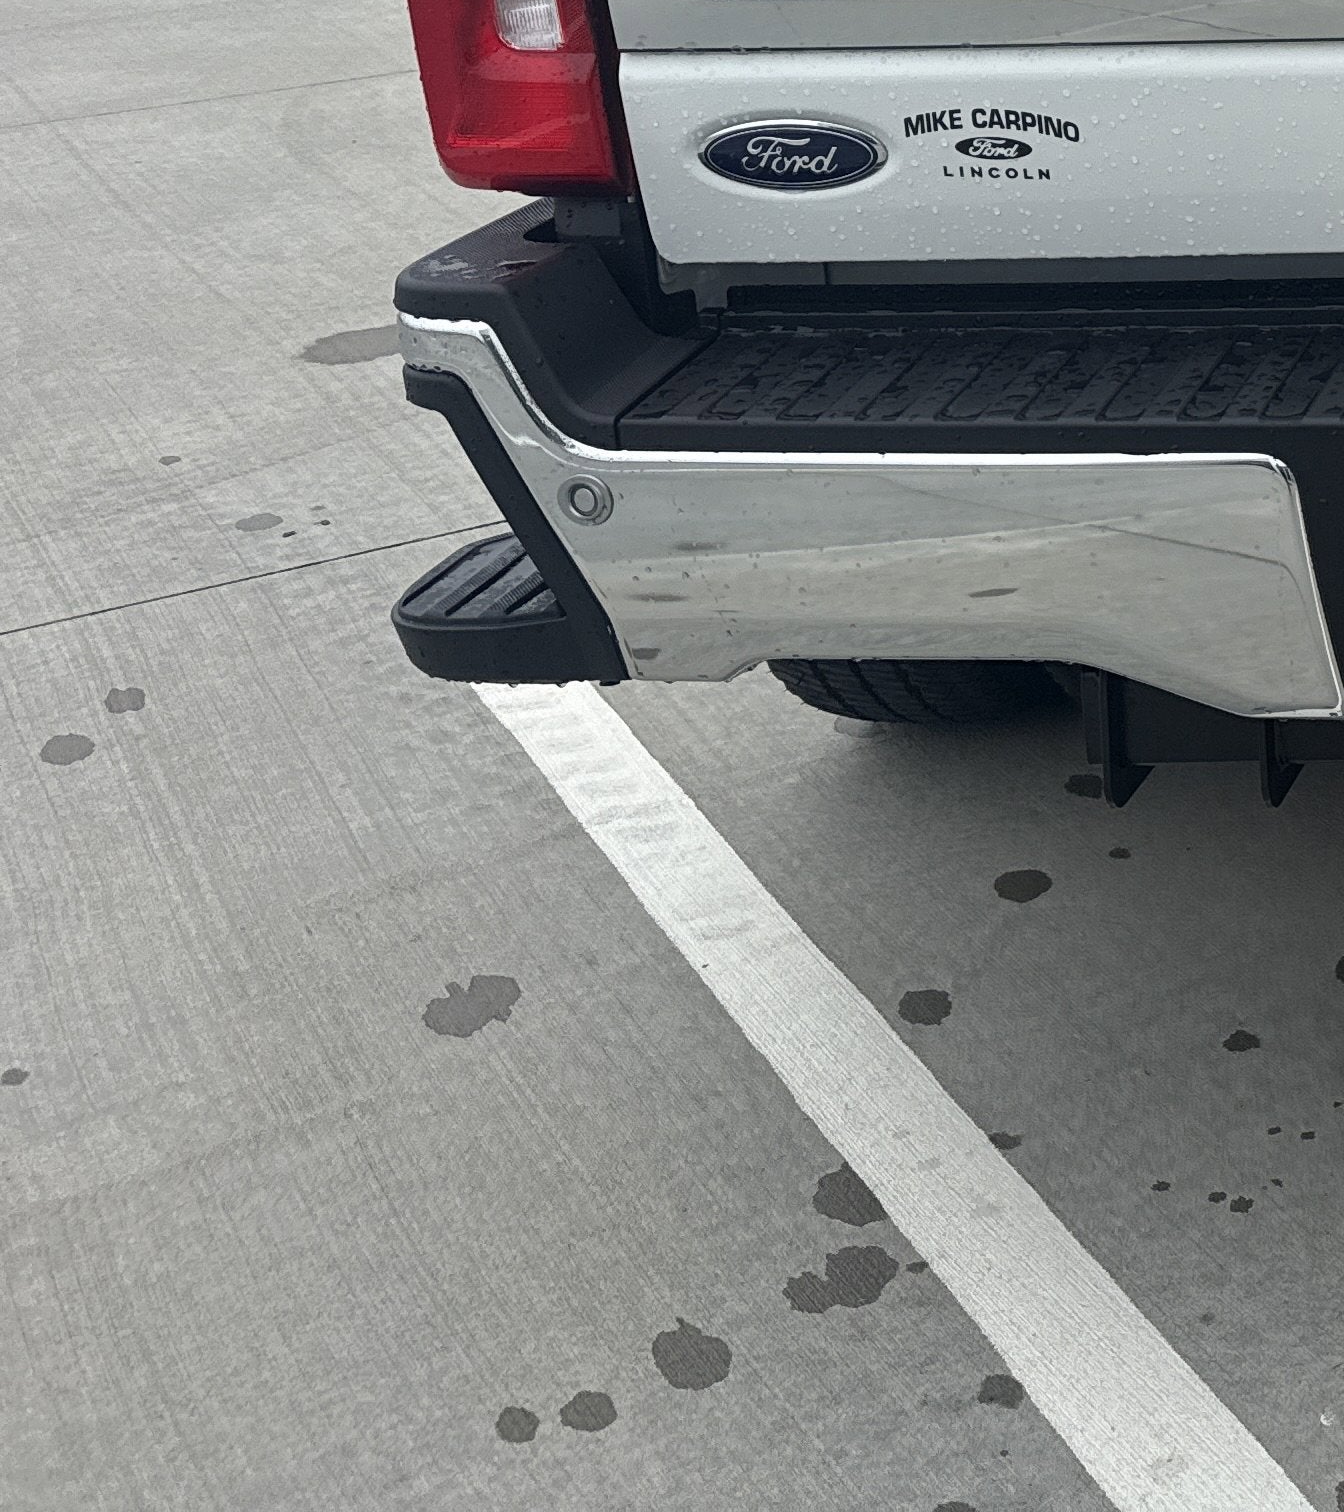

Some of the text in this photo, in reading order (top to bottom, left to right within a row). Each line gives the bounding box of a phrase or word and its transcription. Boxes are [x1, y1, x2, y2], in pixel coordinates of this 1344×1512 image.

[903, 107, 1081, 143] MIKE CARPINO
[741, 135, 839, 176] Ford
[968, 137, 1021, 159] Ford
[942, 164, 1052, 181] LINCOLN
